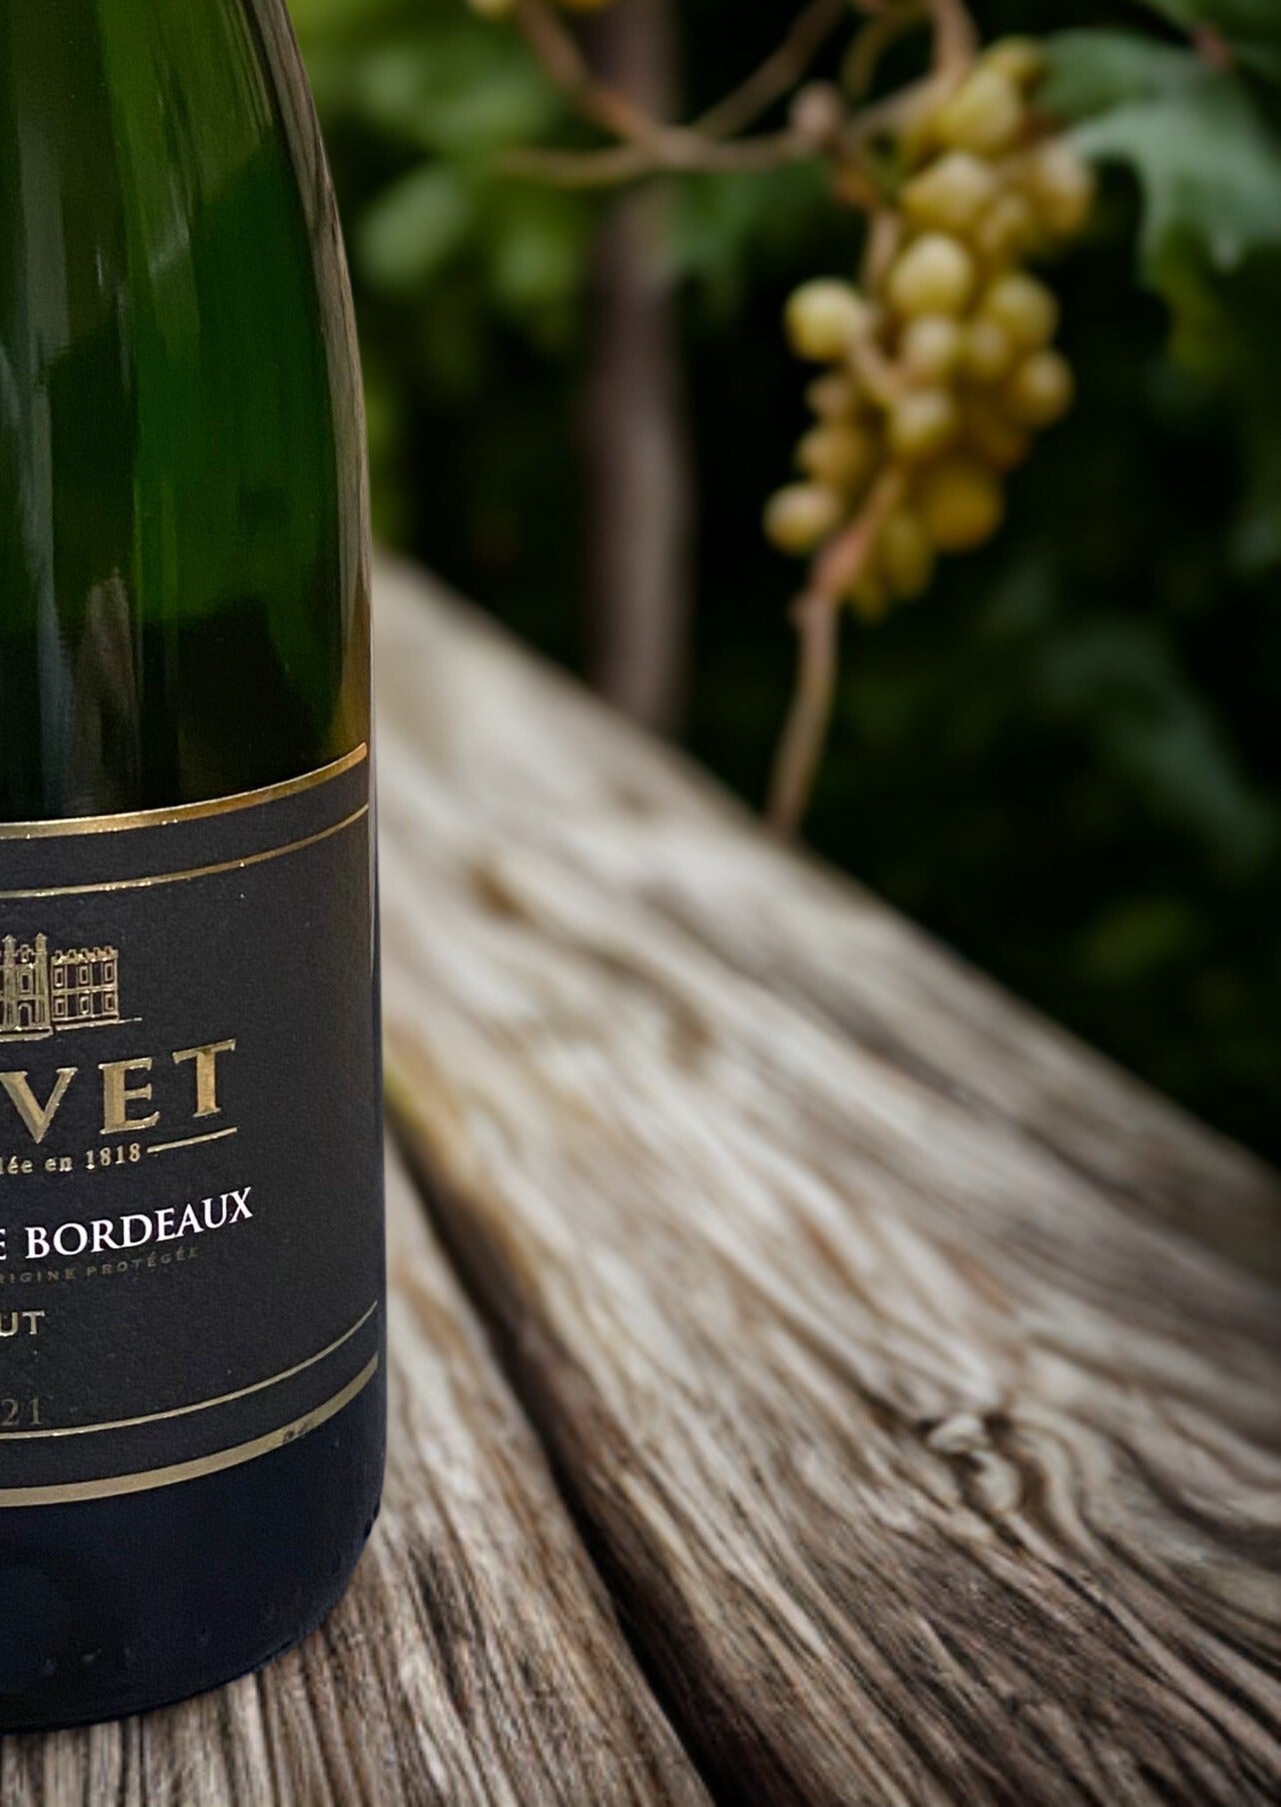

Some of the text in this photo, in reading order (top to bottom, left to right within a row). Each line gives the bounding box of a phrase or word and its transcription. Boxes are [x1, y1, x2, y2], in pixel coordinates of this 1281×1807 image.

[45, 1156, 73, 1172] en
[86, 1143, 141, 1170] 1818
[25, 1187, 253, 1260] BORDEAUX
[86, 1245, 200, 1277] PROTÉGÉE
